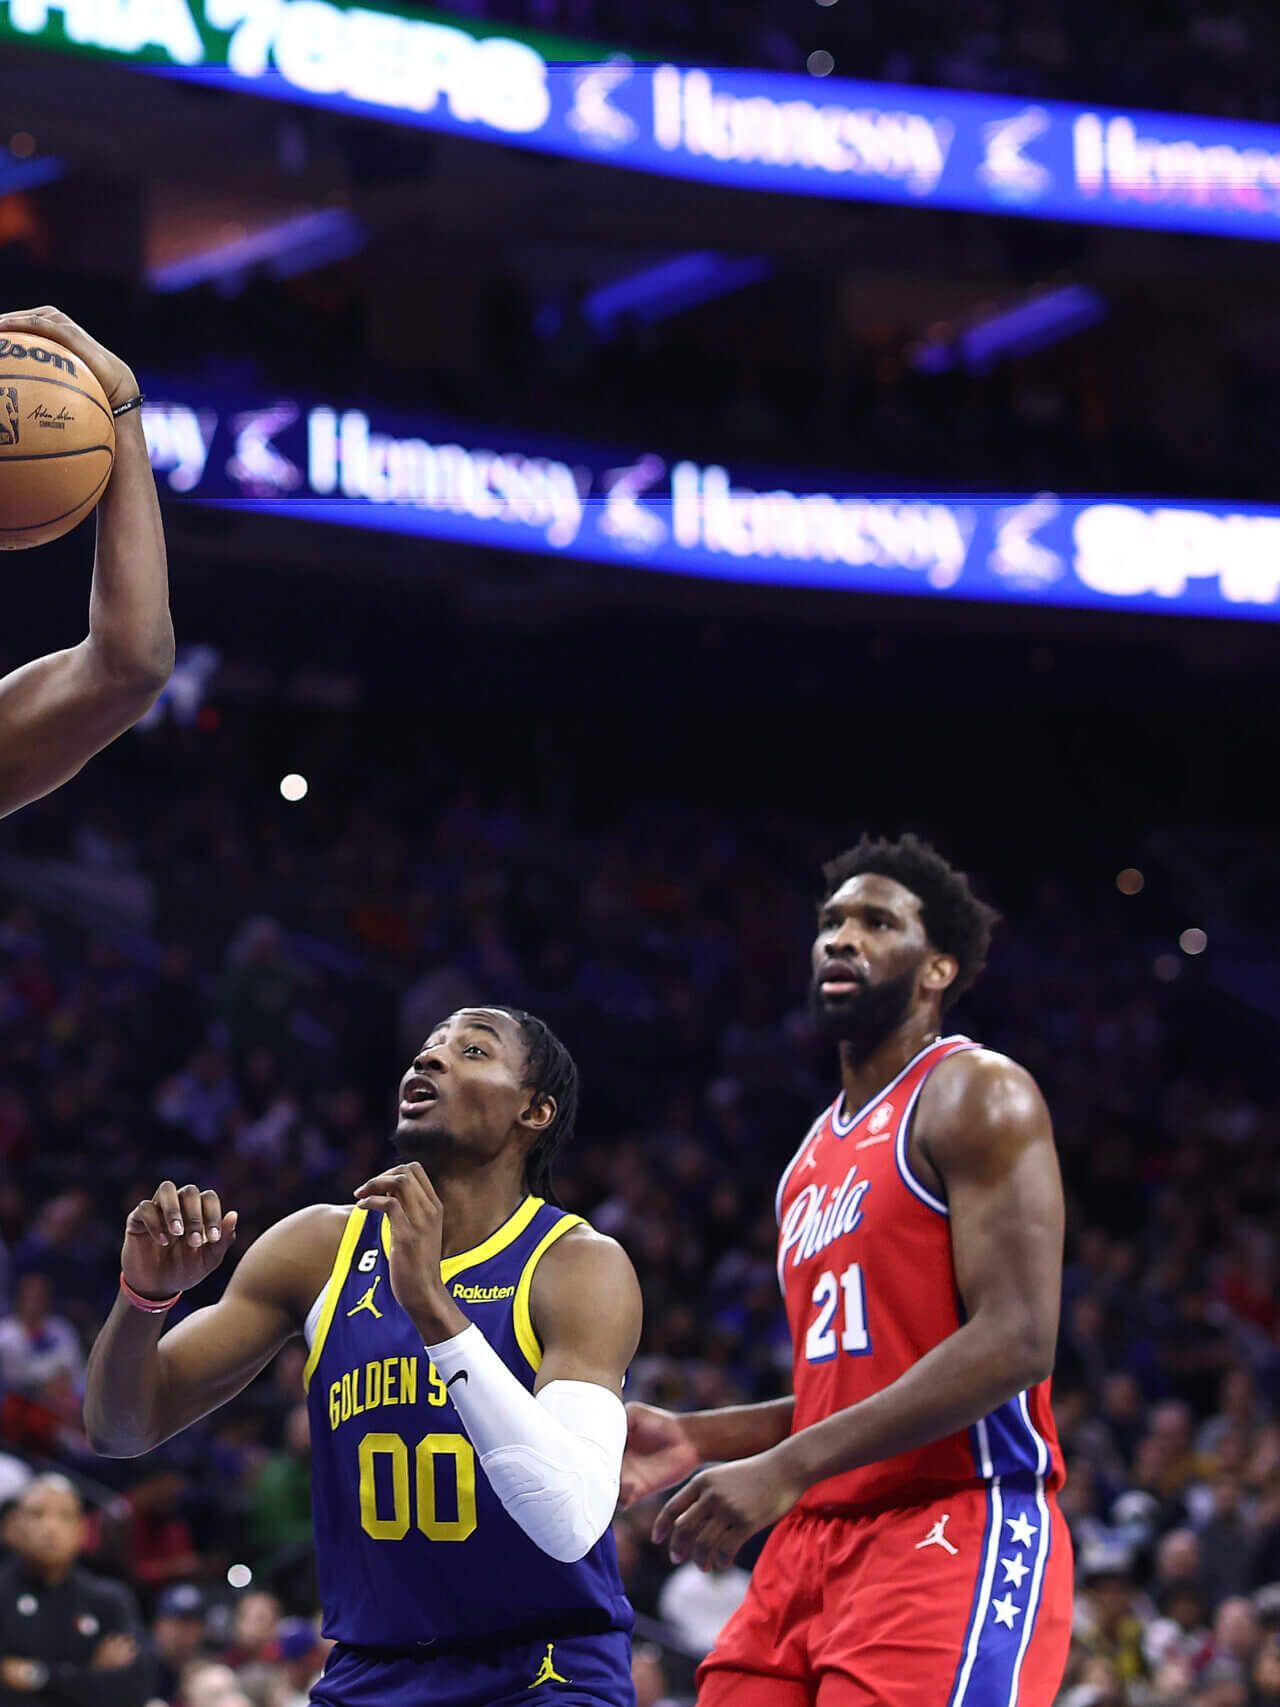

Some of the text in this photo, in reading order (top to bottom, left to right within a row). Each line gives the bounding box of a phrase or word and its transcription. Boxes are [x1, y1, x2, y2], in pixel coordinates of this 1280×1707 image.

[357, 1249, 379, 1272] 6
[781, 1165, 871, 1267] Phila
[453, 1283, 515, 1303] Rakuten
[805, 1262, 873, 1364] 21
[329, 1356, 418, 1432] GOLDEN
[358, 1432, 477, 1542] 00
